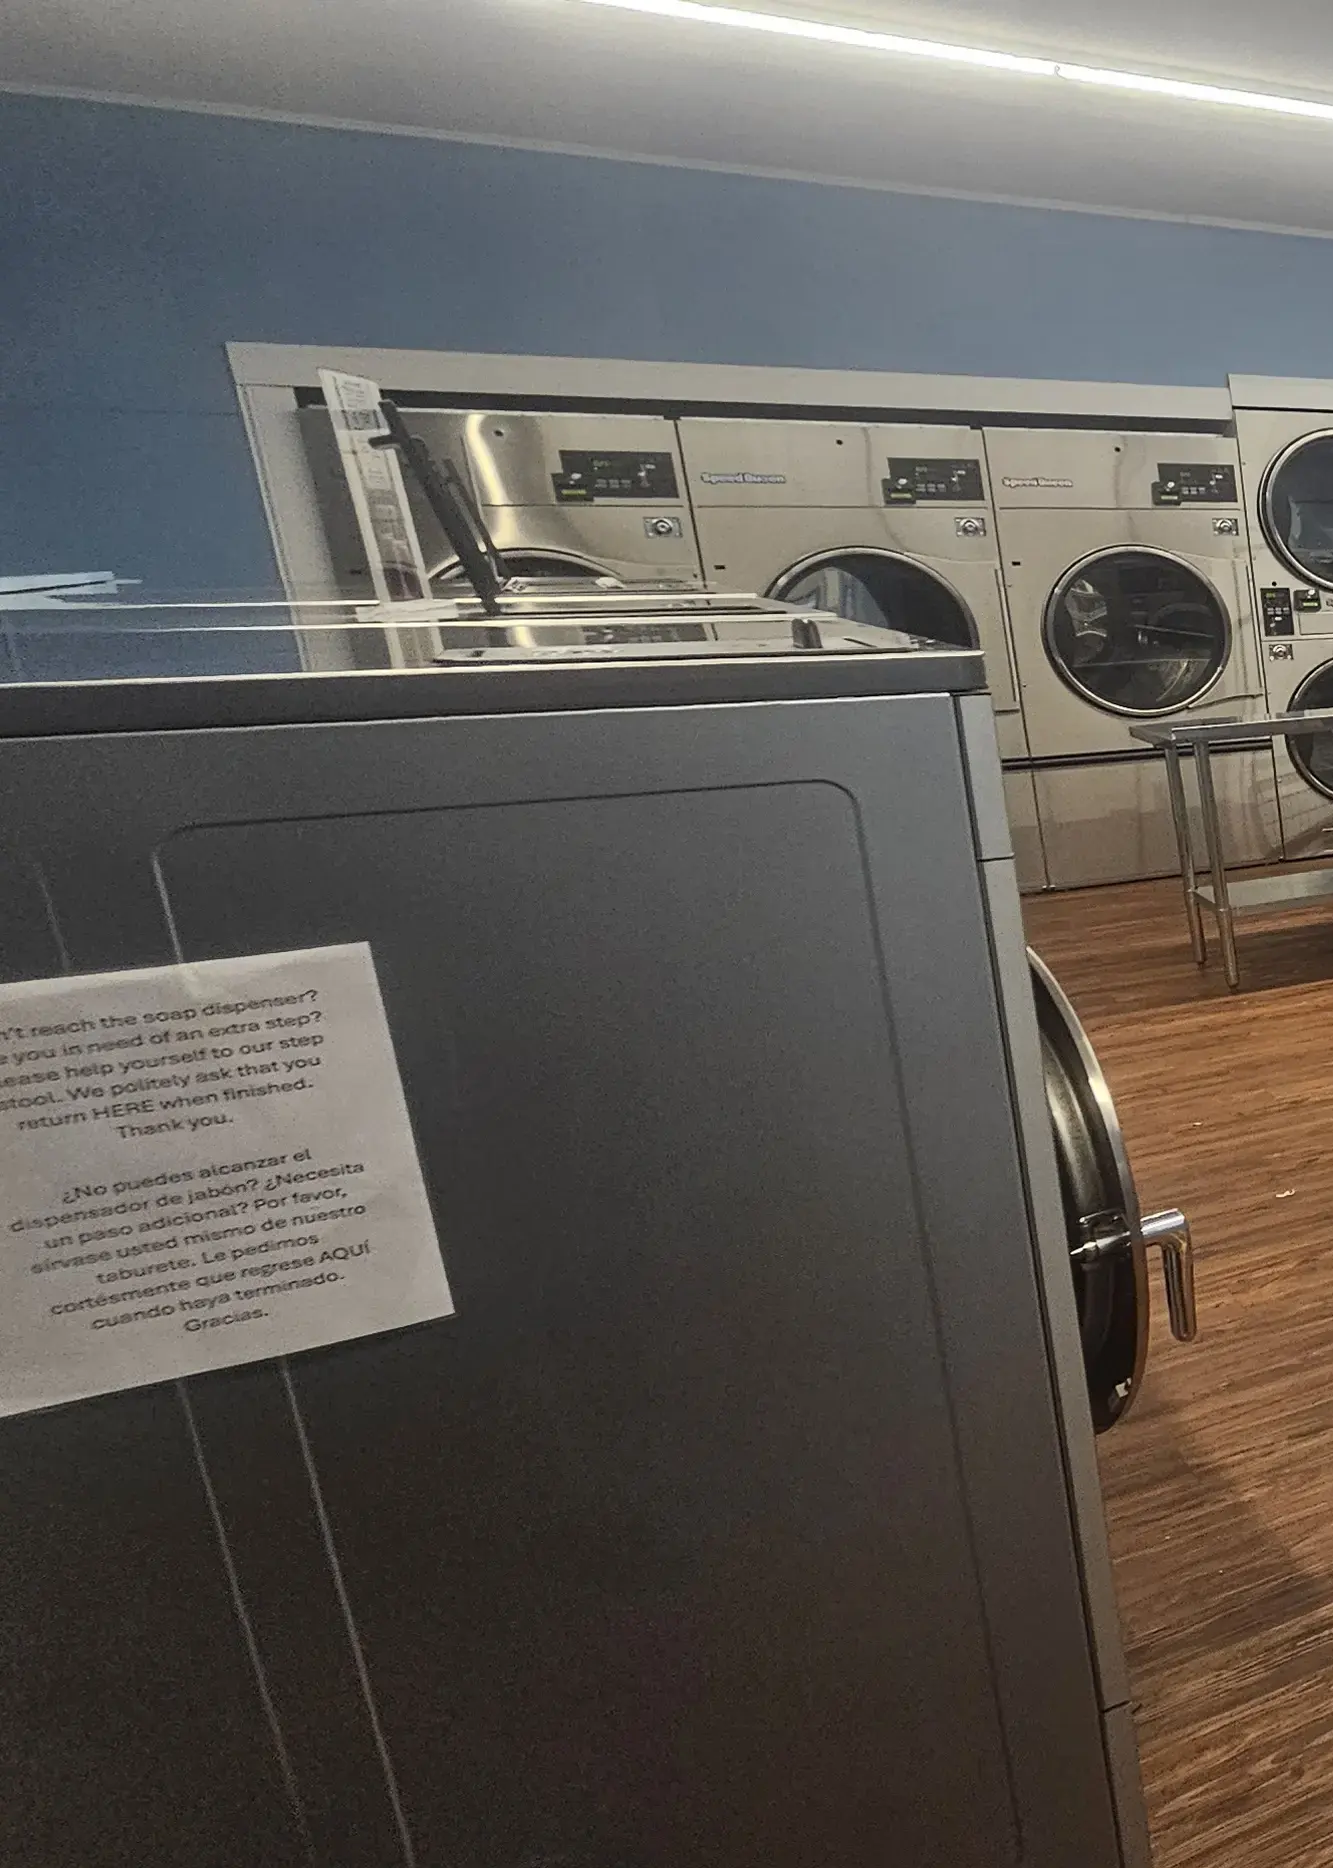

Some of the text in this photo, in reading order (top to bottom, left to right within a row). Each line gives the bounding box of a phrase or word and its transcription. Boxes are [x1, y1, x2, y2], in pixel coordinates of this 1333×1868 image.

[13, 1047, 56, 1066] you
[63, 1044, 83, 1056] in
[87, 1033, 144, 1053] need
[149, 1030, 171, 1045] of
[175, 1028, 205, 1042] an
[208, 1021, 261, 1038] extra
[265, 1010, 322, 1029] step?
[31, 1019, 96, 1037] reach
[100, 1015, 138, 1029] the
[143, 1008, 197, 1024] soap
[201, 988, 318, 1016] dispenser?
[64, 1063, 114, 1079] help
[118, 1047, 209, 1075] yourself
[211, 1047, 234, 1060] to
[238, 1040, 273, 1055] our
[279, 1034, 325, 1050] step
[66, 1085, 104, 1102] We
[110, 1074, 191, 1098] politely
[195, 1067, 233, 1083] ask
[237, 1061, 280, 1077] that
[281, 1056, 321, 1074] you
[18, 1077, 314, 1131] return HERE when finished.
[115, 1113, 234, 1139] Thank you.
[9, 1200, 151, 1233] dispensador
[155, 1192, 184, 1208] de
[263, 1162, 365, 1192] ¿Necesita
[62, 1149, 313, 1205] ¿No puedes alcanzar el
[44, 1187, 348, 1250] un paso adicional? Por favor,
[115, 1236, 178, 1258] usted
[183, 1224, 256, 1246] mismo
[260, 1217, 288, 1232] de
[291, 1203, 367, 1226] nuestro
[95, 1234, 320, 1284] taburete. Le pedimos
[195, 1270, 236, 1289] que
[240, 1255, 316, 1278] regrese
[91, 1271, 345, 1330] cuando haya terminado.
[183, 1308, 269, 1332] Gracias.
